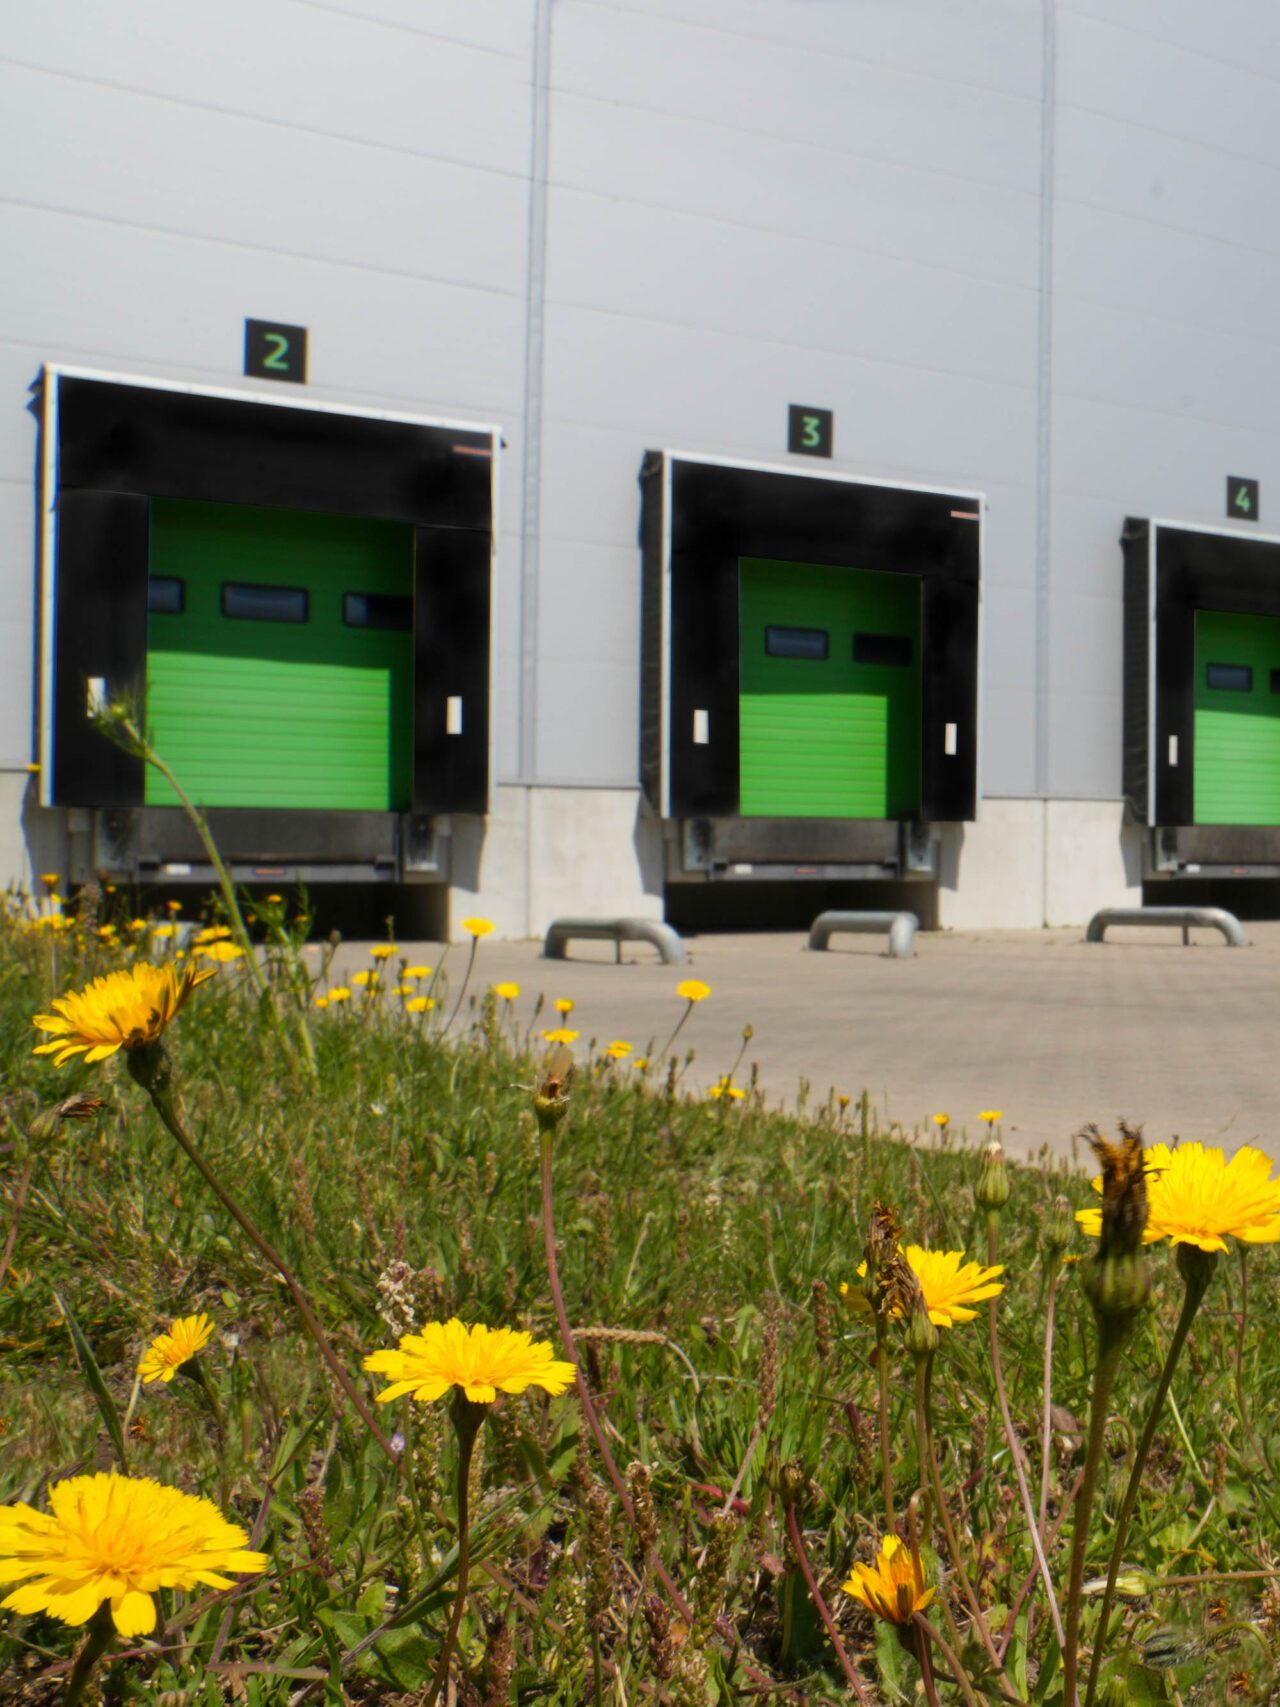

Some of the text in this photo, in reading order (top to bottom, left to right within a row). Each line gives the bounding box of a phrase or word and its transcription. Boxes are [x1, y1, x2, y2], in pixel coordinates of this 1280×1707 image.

[263, 333, 289, 370] 2
[801, 415, 820, 447] 3
[1235, 487, 1251, 512] 4
